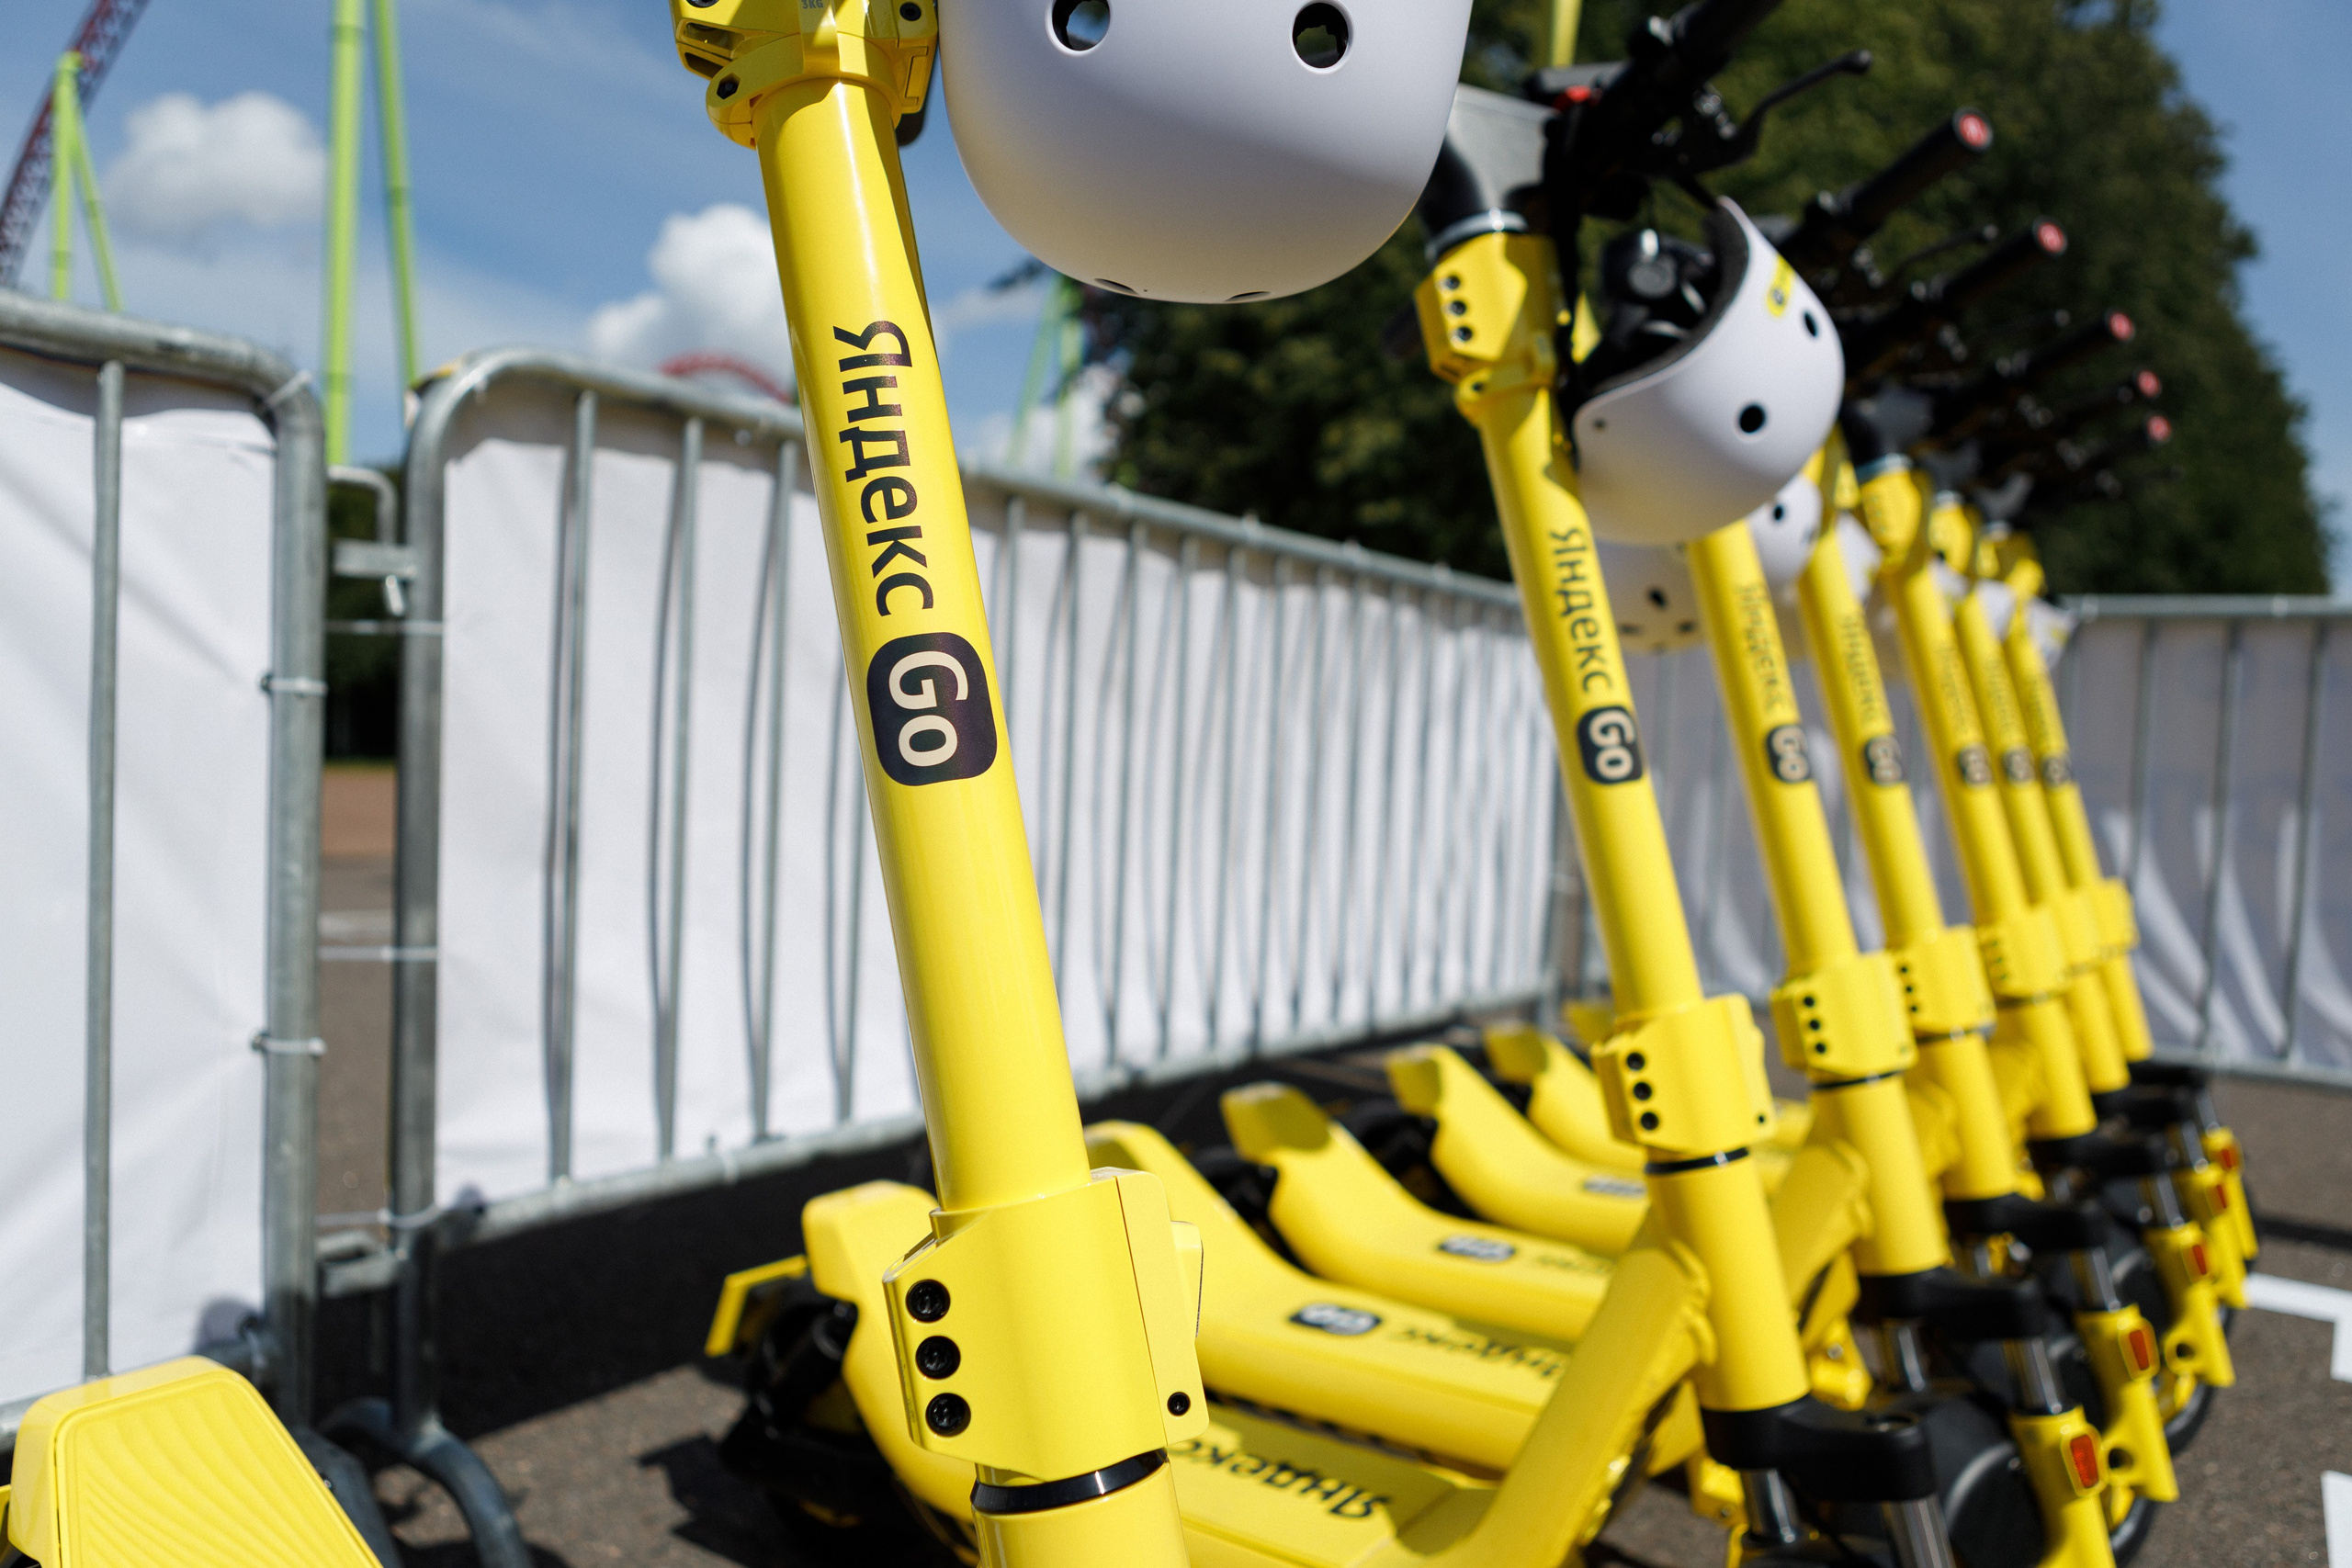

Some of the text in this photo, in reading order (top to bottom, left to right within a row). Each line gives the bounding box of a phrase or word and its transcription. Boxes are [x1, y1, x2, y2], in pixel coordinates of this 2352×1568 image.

[801, 0, 824, 9] 3KG
[833, 321, 933, 616] Яндекс
[1549, 527, 1613, 693] Яндекс
[1166, 1440, 1392, 1518] Яндекс
